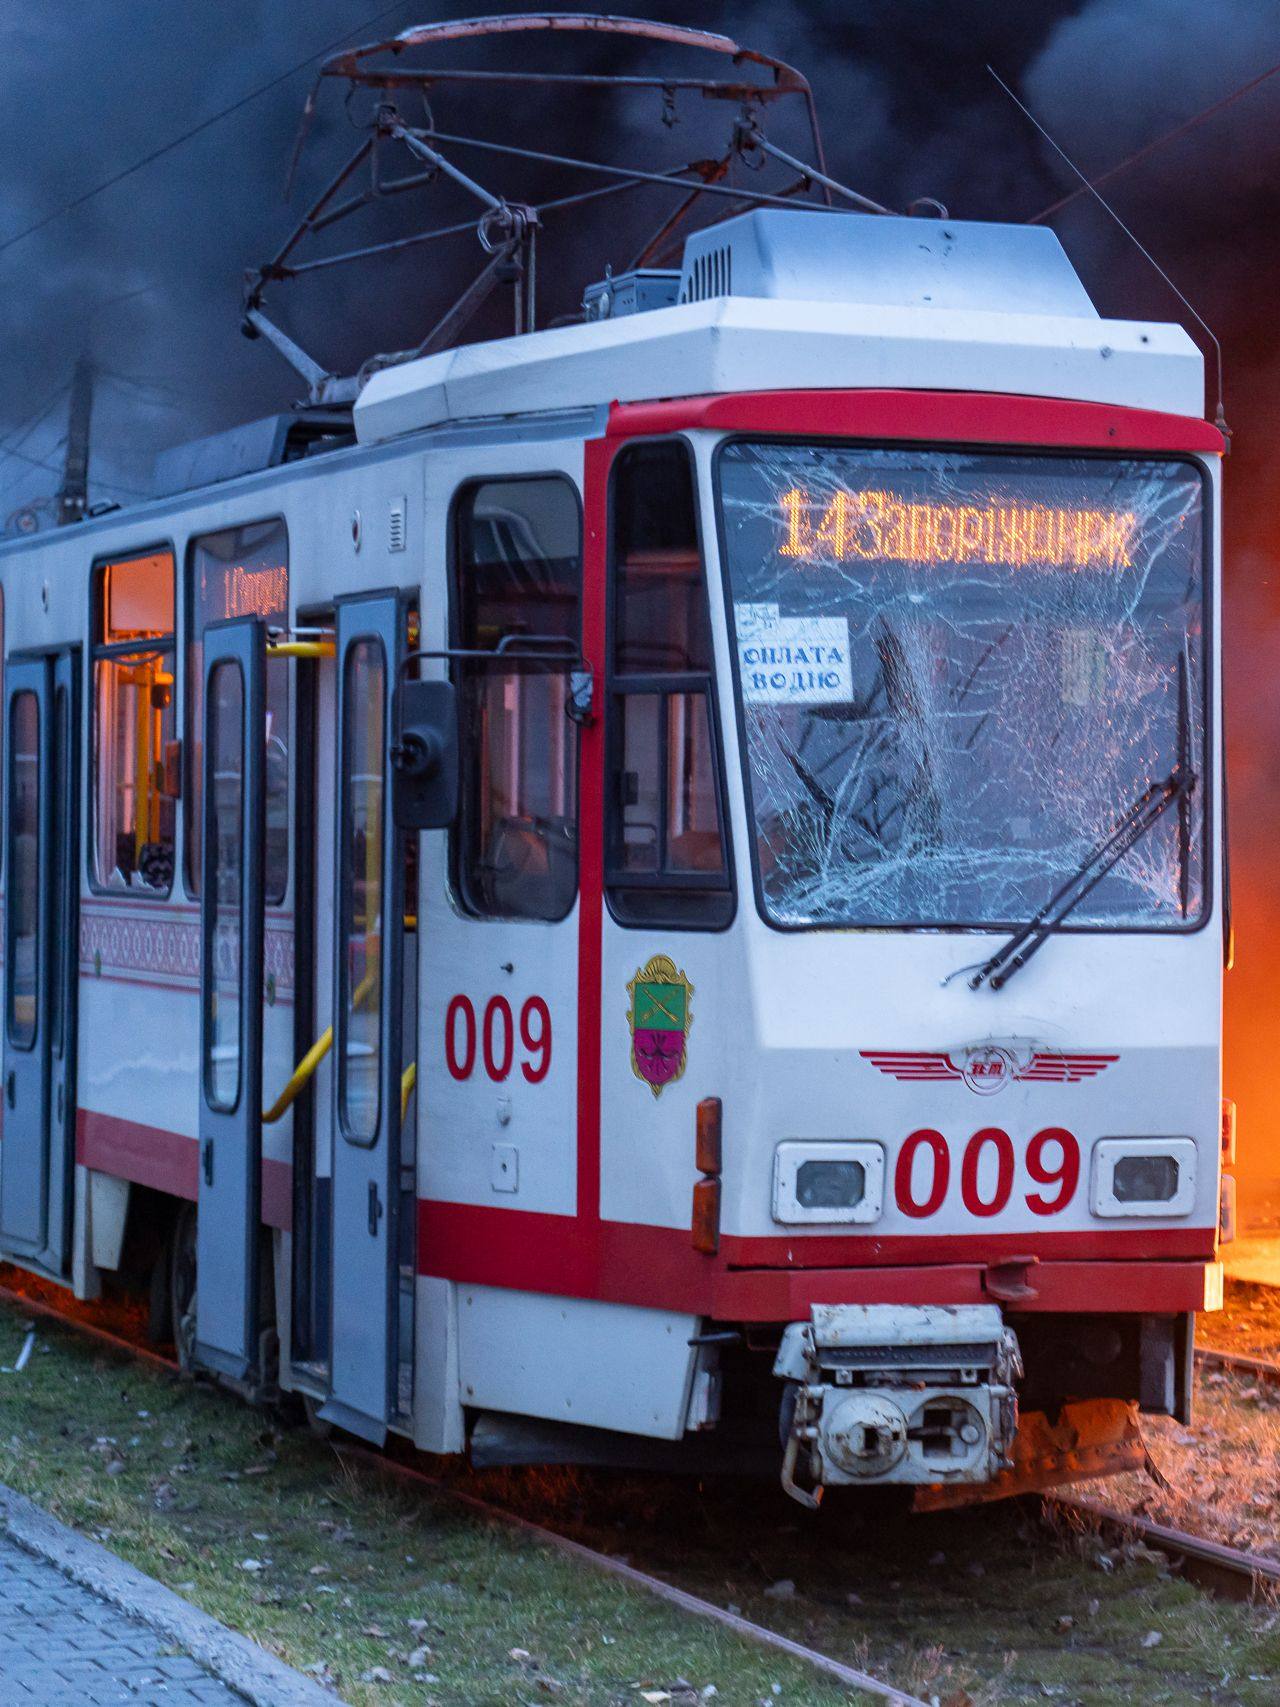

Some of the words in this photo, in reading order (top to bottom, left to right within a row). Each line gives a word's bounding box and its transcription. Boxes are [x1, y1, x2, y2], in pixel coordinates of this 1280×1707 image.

[778, 488, 849, 562] 14
[743, 646, 844, 665] ОПЛАТА
[445, 994, 552, 1084] 009
[894, 1127, 1080, 1218] 009
